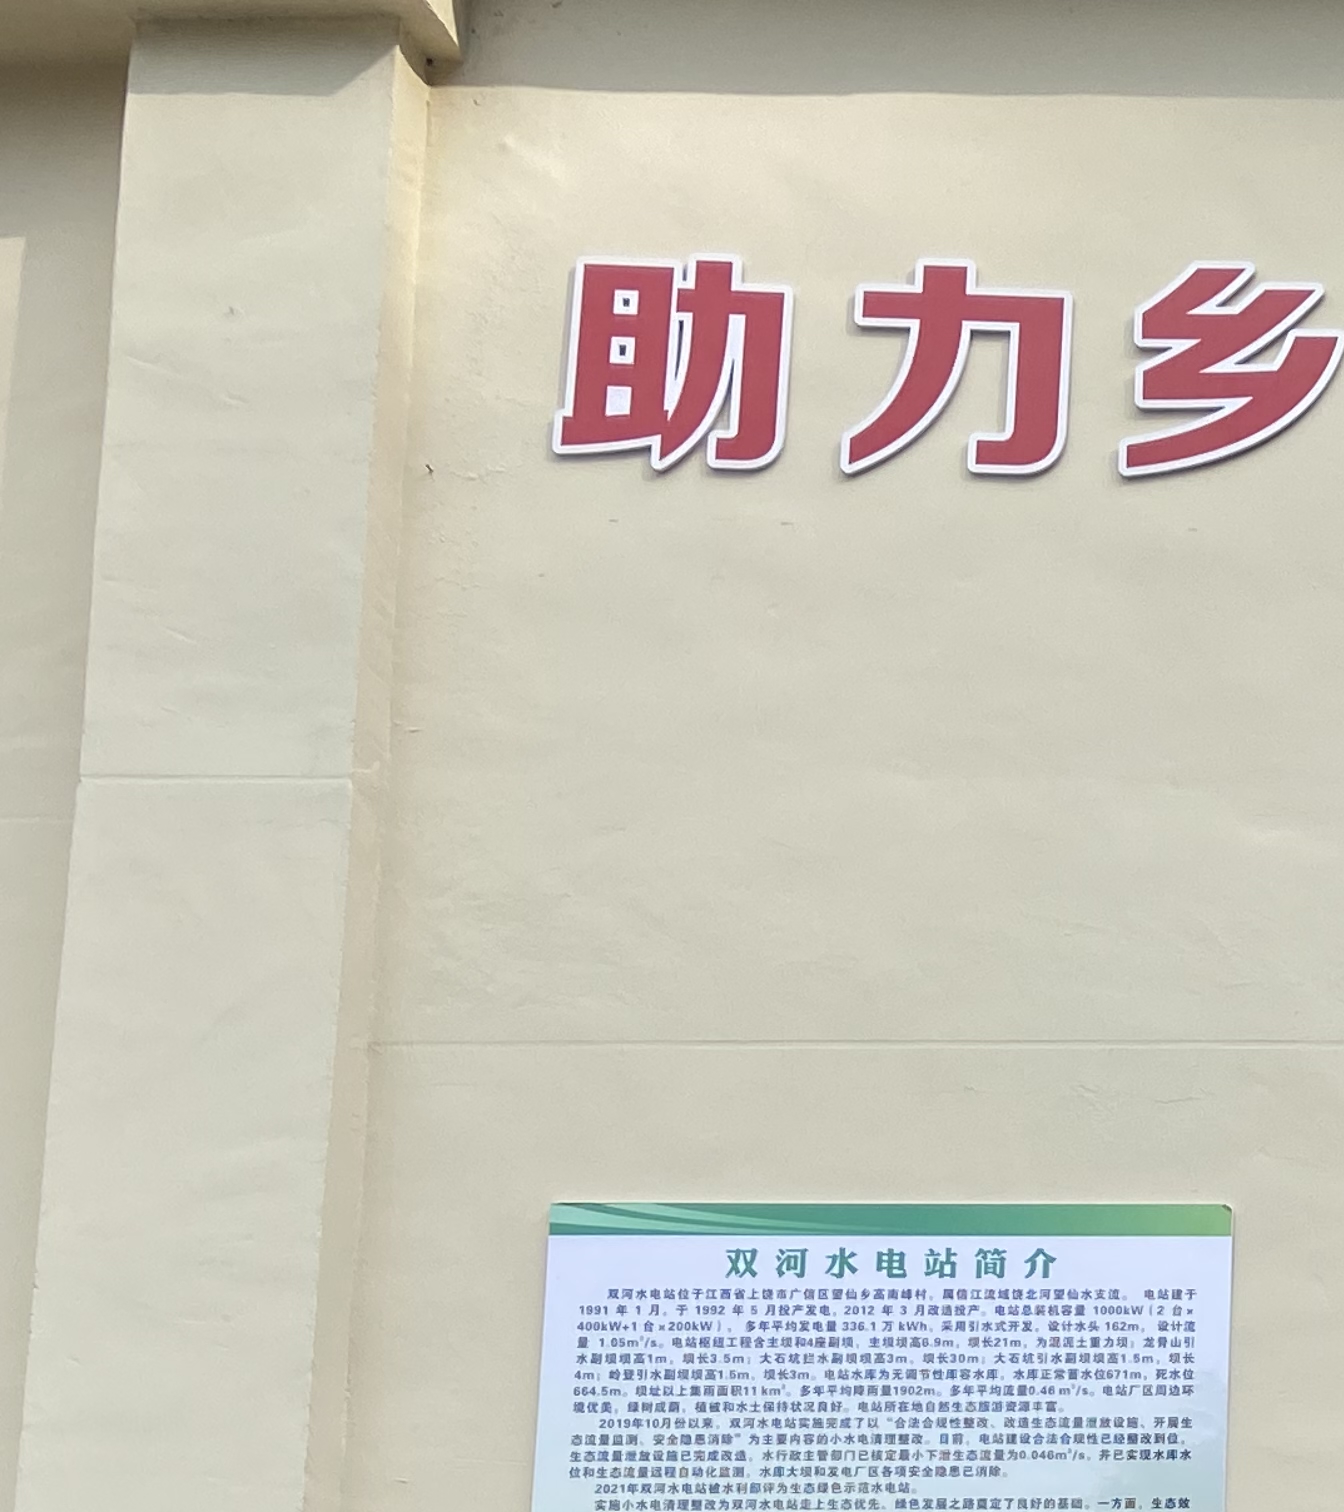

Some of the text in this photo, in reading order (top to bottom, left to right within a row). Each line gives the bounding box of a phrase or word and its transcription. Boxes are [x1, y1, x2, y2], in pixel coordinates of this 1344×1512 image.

[725, 1248, 1057, 1279] 双河水电站简介
